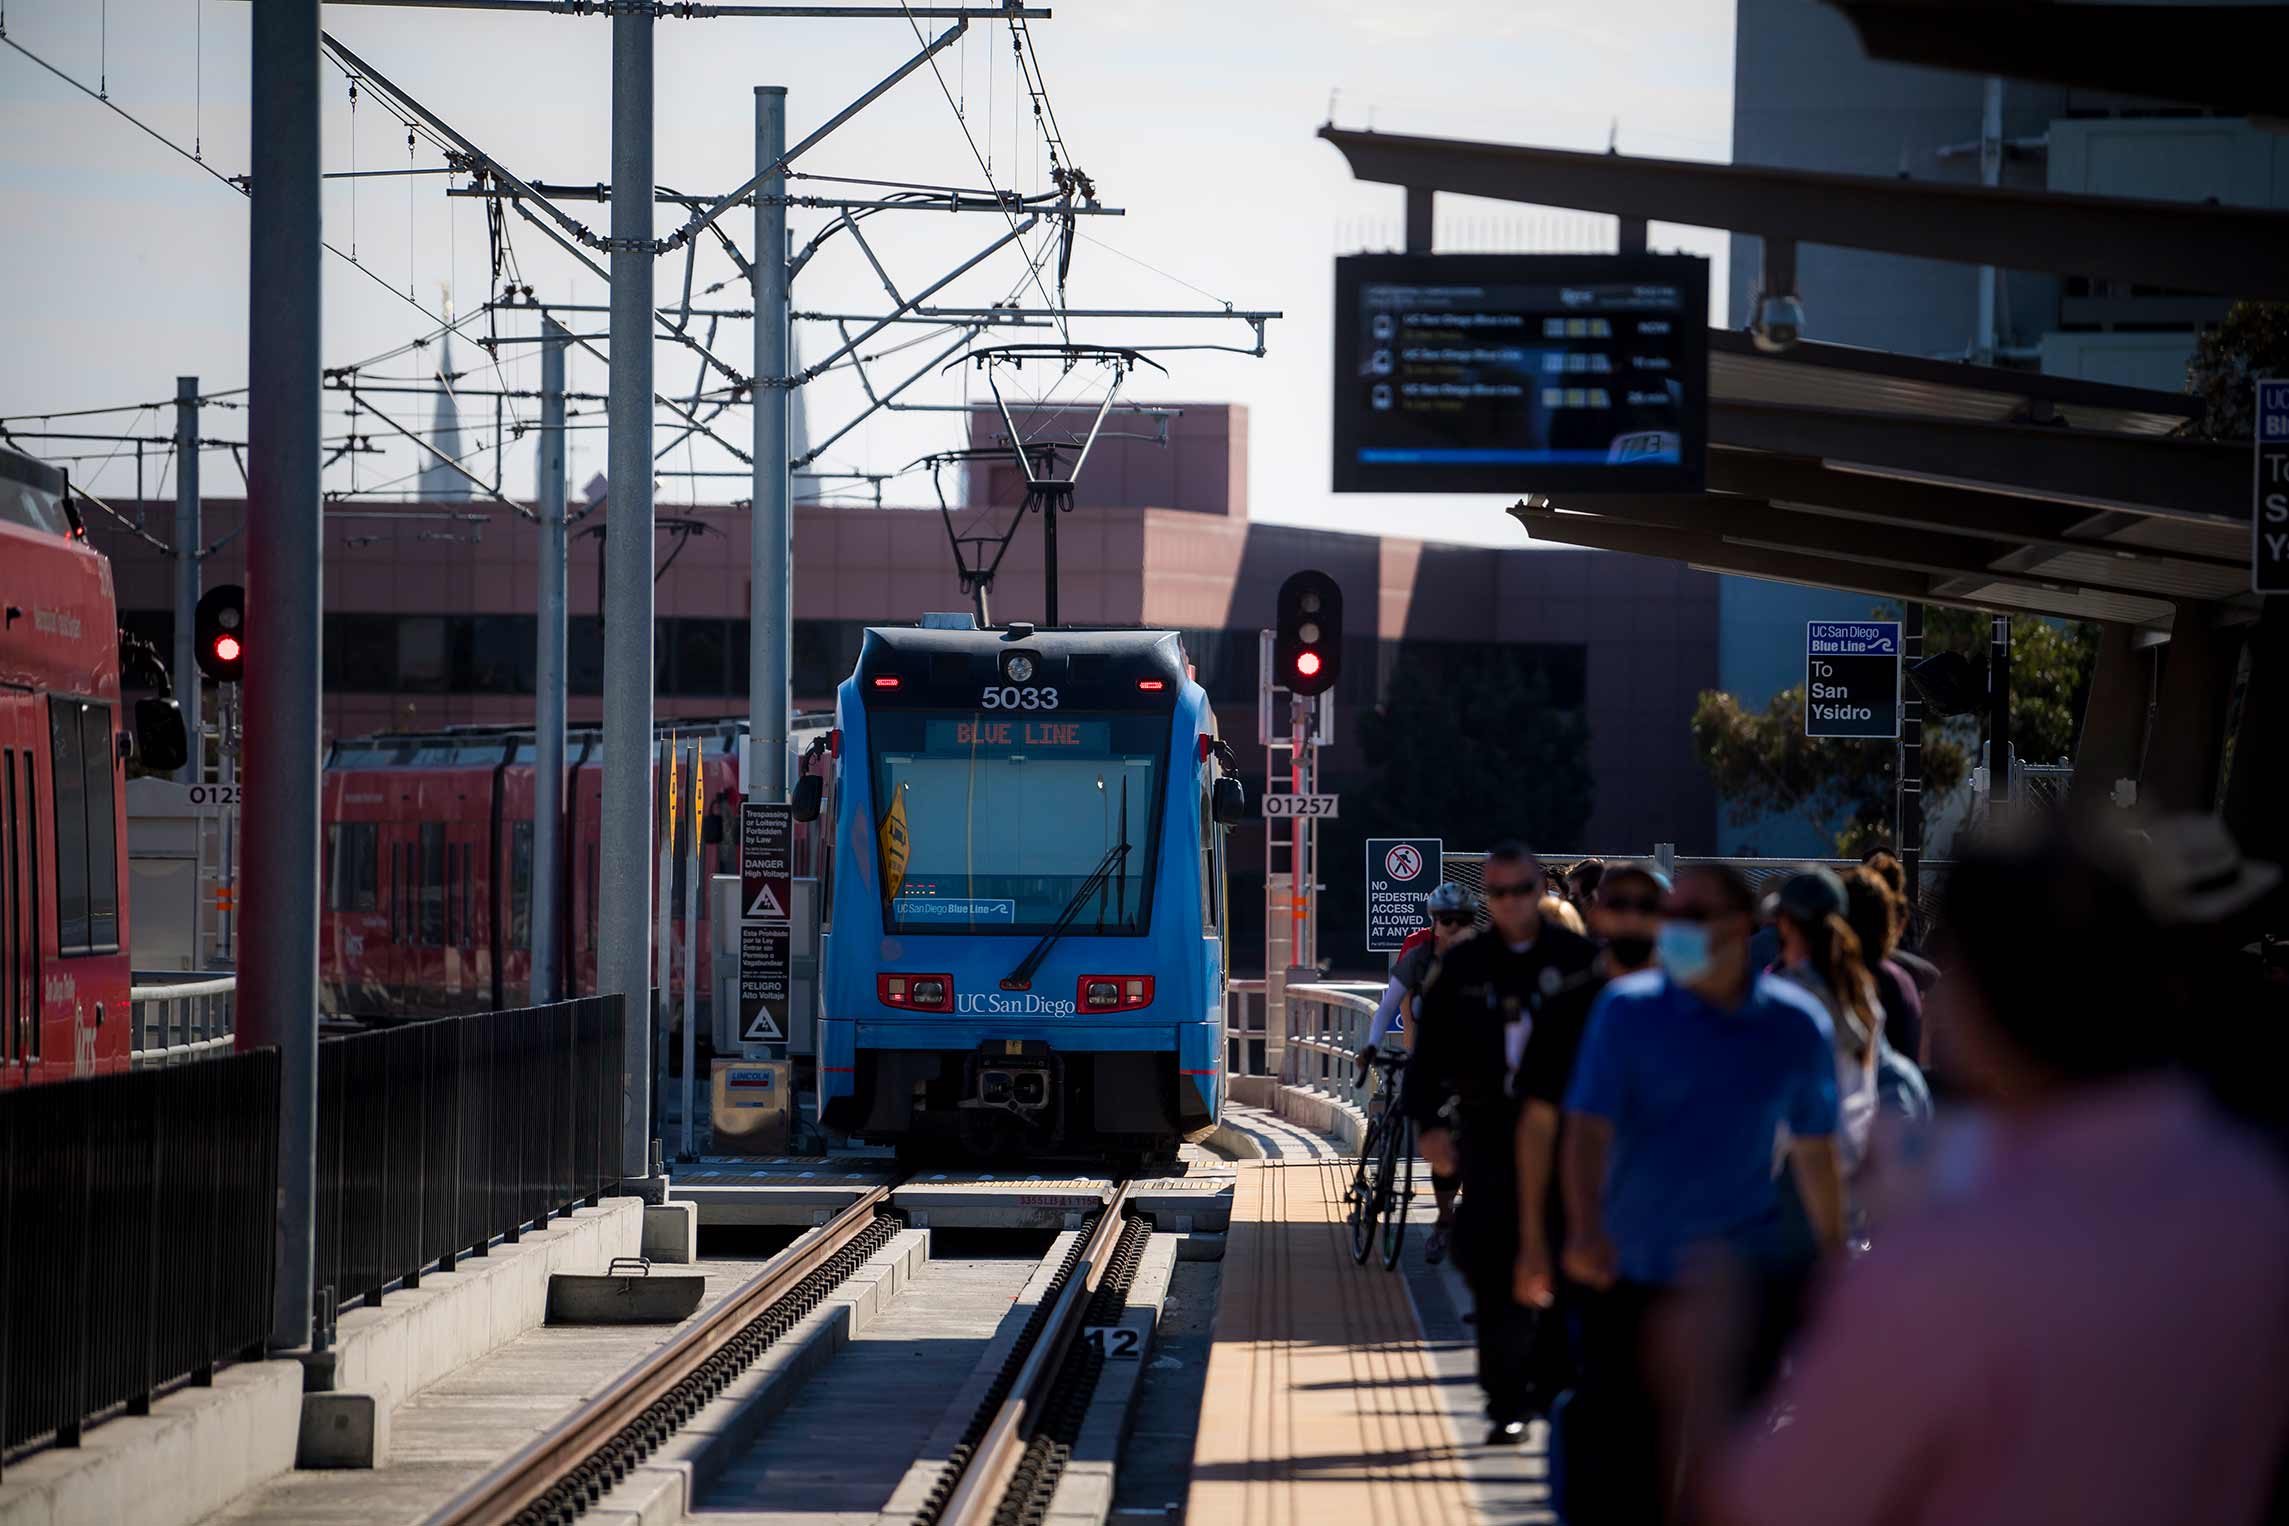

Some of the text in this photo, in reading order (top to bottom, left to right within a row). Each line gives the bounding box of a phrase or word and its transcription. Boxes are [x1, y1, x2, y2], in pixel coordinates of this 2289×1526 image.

[1812, 626, 1880, 640] UC San Diego
[1812, 640, 1866, 652] Blue Line
[1811, 661, 1833, 677] To
[1812, 682, 1848, 699] San
[981, 686, 1059, 710] 5033
[1811, 704, 1872, 720] Ysidro
[957, 723, 1080, 745] BLUE LINE
[746, 810, 789, 820] Trespassing
[755, 820, 787, 828] Loitering
[746, 827, 783, 835] Forbidden
[745, 835, 771, 844] by Law
[745, 860, 784, 869] DANGER
[744, 870, 789, 878] High Voltage
[1371, 881, 1388, 891] NO
[1371, 892, 1432, 902] PEDESTRIA
[897, 904, 989, 915] UC San Diego Blue Line
[1371, 904, 1415, 913] ACCESS
[1371, 915, 1424, 925] ALLOWED
[1371, 927, 1385, 937] AT
[1386, 927, 1409, 937] ANY
[742, 982, 782, 991] PELIGRO
[742, 991, 785, 1000] Alto Voltaje
[957, 993, 1075, 1018] UC San Diego
[732, 1071, 770, 1080] LINCOLN
